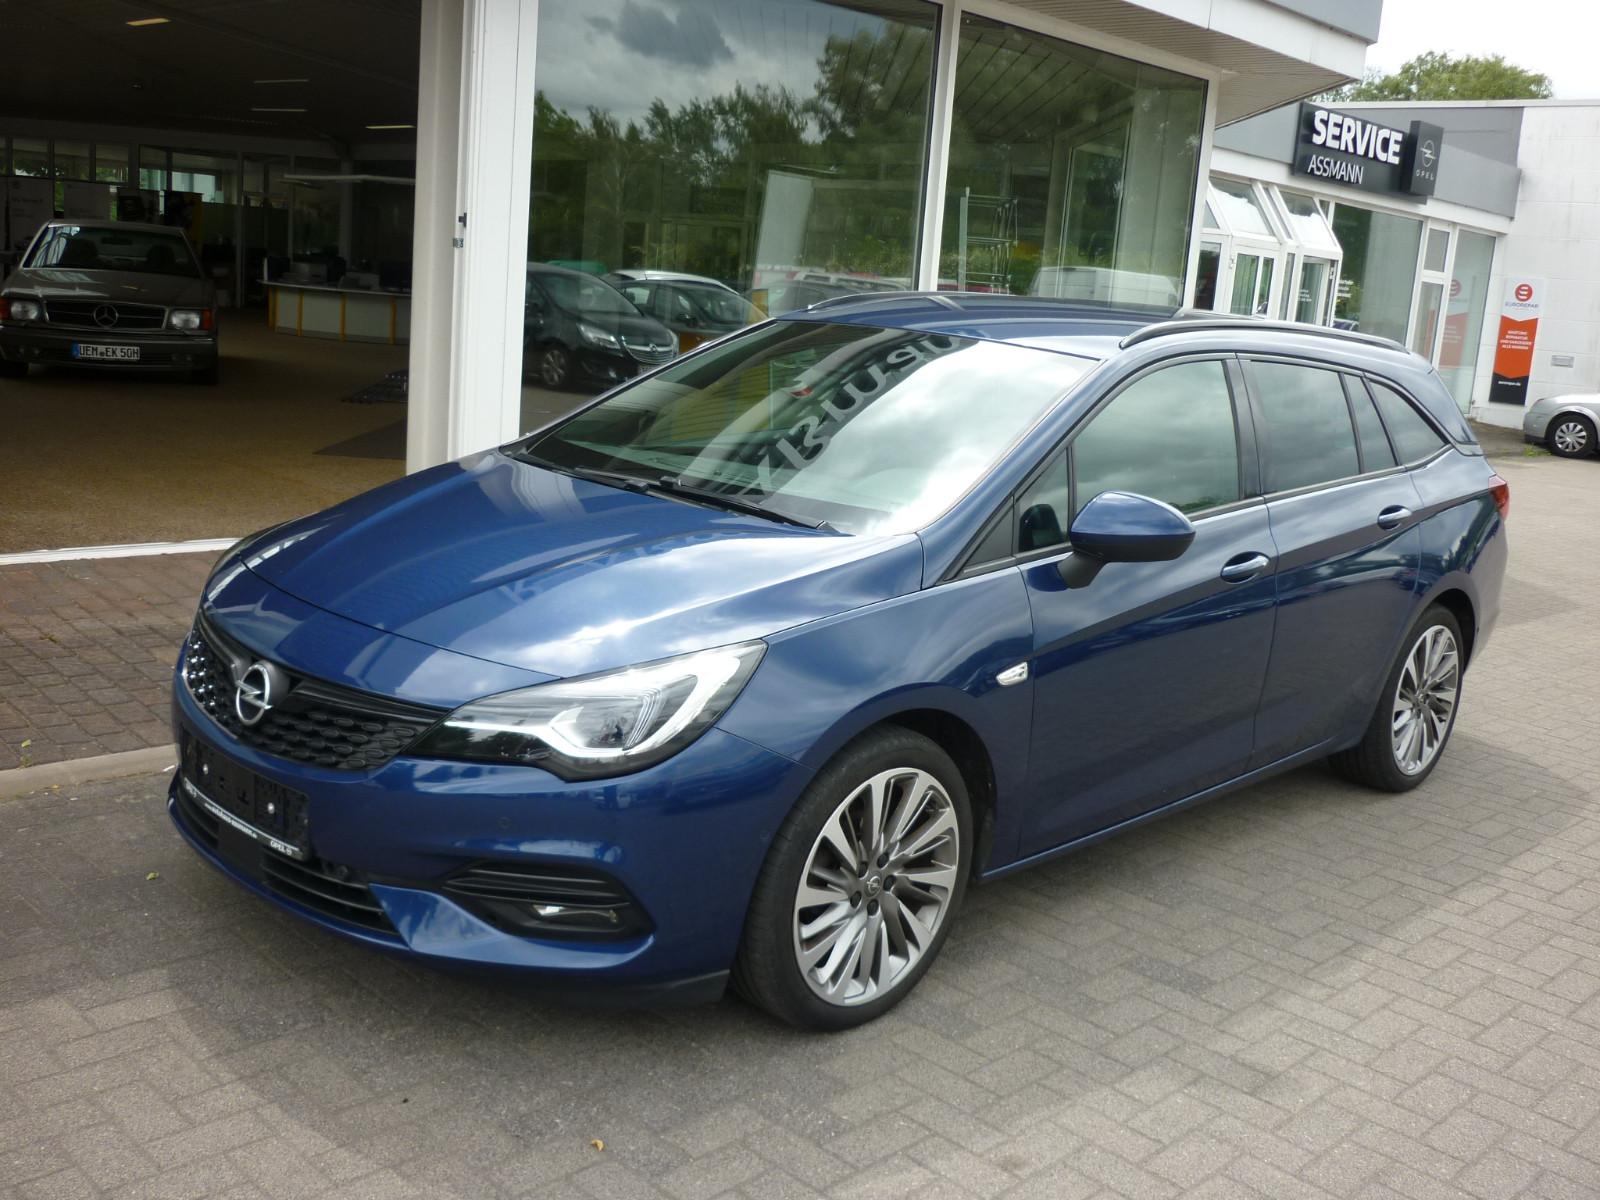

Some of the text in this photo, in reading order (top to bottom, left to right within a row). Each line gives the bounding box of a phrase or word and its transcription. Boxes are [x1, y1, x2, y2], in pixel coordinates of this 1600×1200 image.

[1311, 109, 1403, 165] SERVICE
[1307, 154, 1364, 184] ASSMANN
[1415, 169, 1434, 181] OPEL
[105, 346, 118, 358] EK
